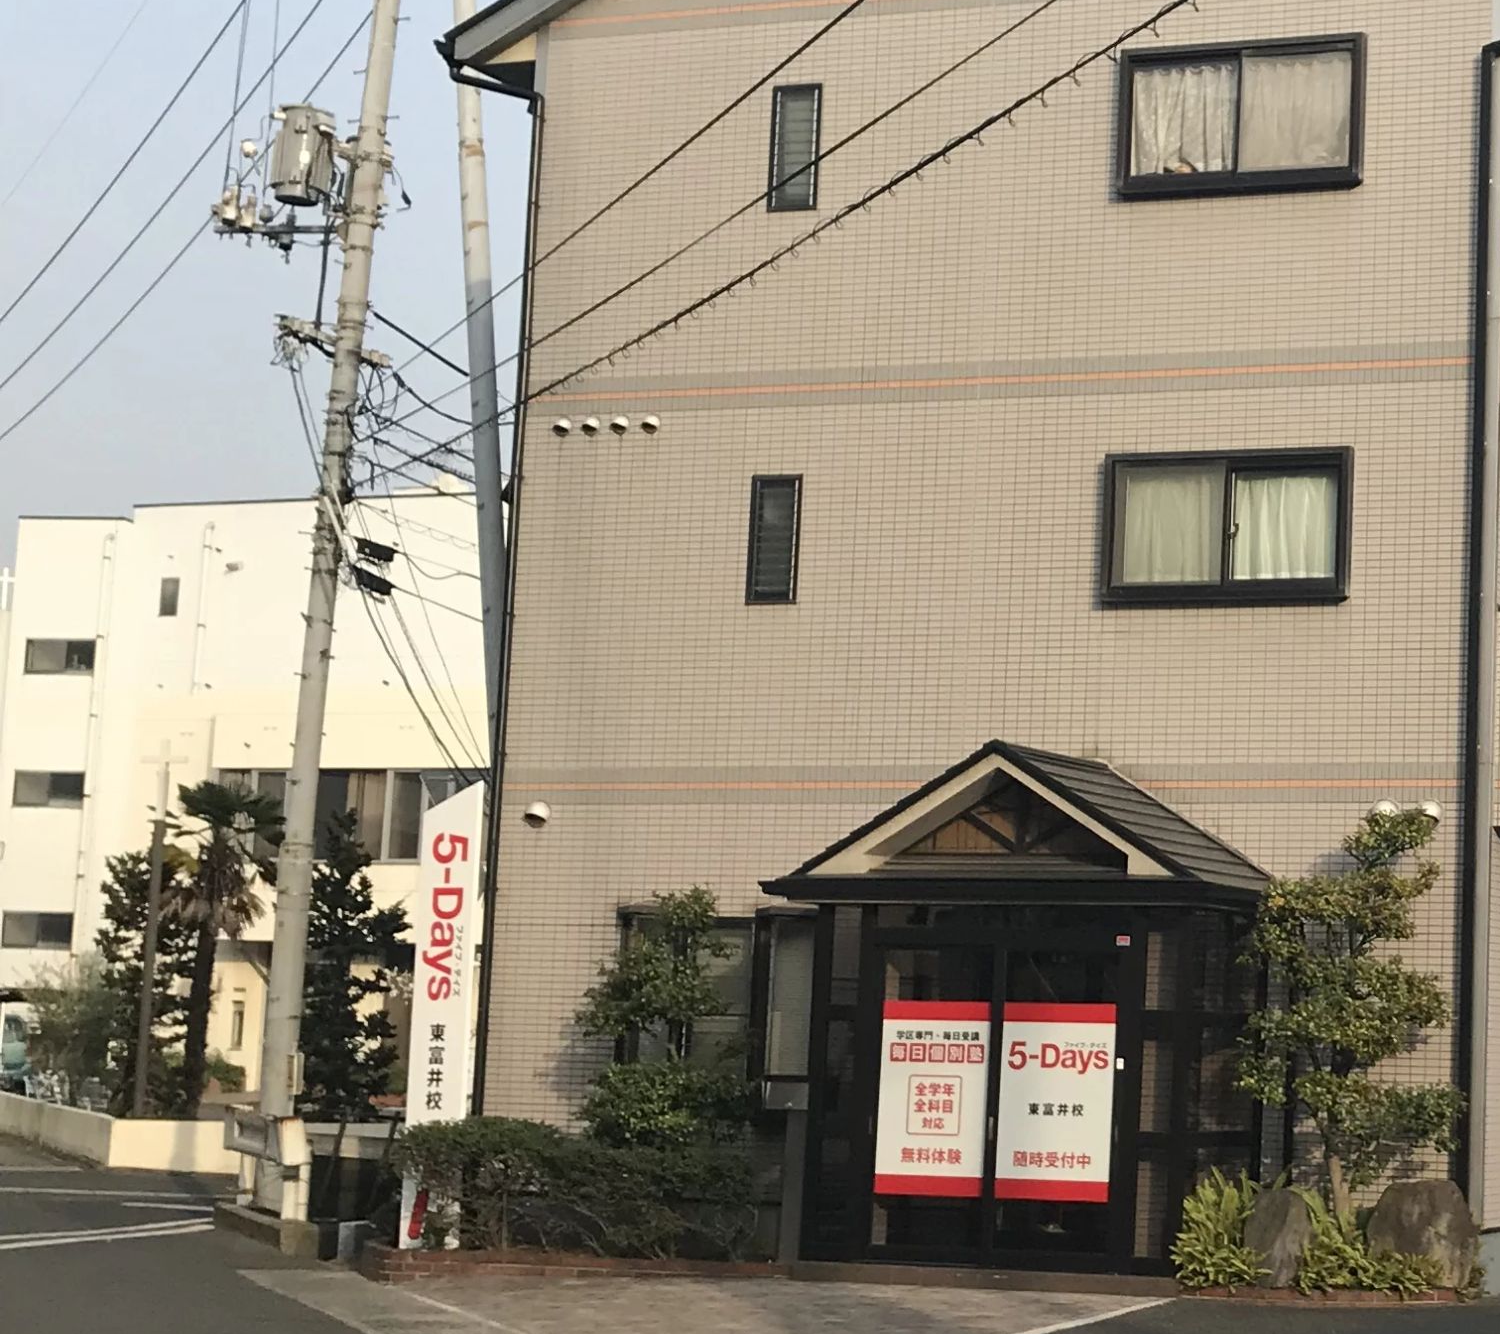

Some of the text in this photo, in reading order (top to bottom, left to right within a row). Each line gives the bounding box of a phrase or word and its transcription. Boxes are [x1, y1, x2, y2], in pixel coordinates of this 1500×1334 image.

[422, 831, 469, 1002] 5-Days
[890, 1043, 984, 1064] 毎日個別塾
[1008, 1040, 1109, 1075] 5-Days
[426, 1023, 445, 1111] 東富井校
[915, 1082, 955, 1097] 全学年
[914, 1099, 953, 1114] 全科目
[1028, 1102, 1084, 1117] 東富井校
[921, 1116, 945, 1130] 対応
[901, 1147, 962, 1165] 無料体験
[1013, 1150, 1091, 1170] 随時受付中
